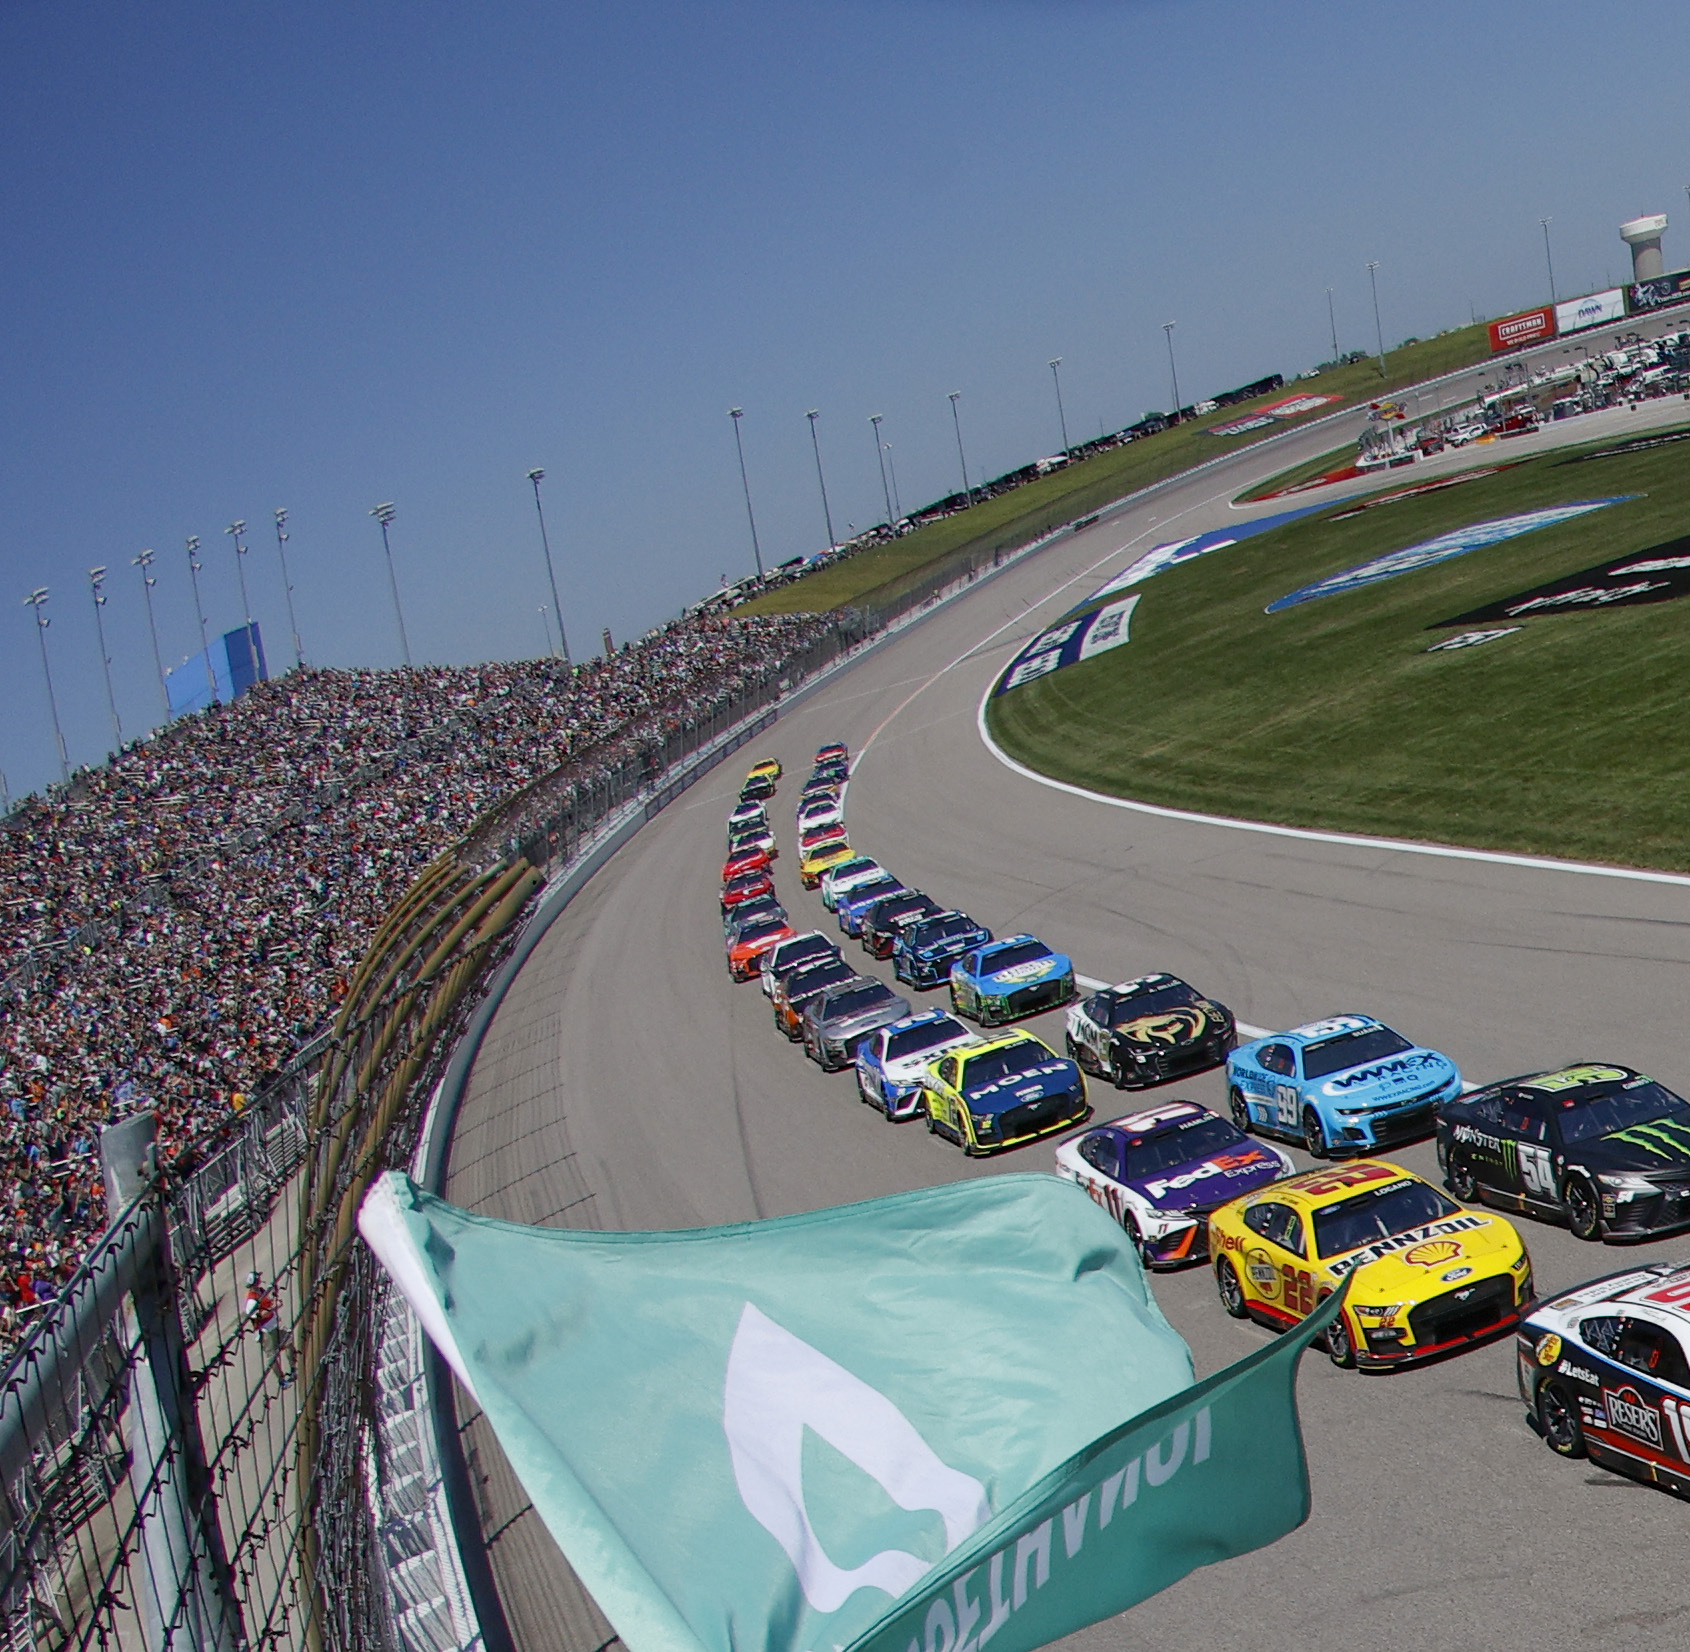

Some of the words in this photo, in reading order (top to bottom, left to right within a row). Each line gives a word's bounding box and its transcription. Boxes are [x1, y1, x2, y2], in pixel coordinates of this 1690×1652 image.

[969, 1060, 1070, 1101] MOEN
[1277, 1084, 1298, 1127] 99
[1144, 1150, 1267, 1199] FedEx
[1224, 1160, 1281, 1178] Express
[1375, 1180, 1413, 1197] LOGANO
[1519, 1144, 1551, 1194] 54
[1215, 1228, 1246, 1251] Shell
[1329, 1216, 1491, 1277] PENNZOIL
[1282, 1262, 1315, 1315] 22
[1558, 1358, 1600, 1387] #LetsEat
[1610, 1397, 1660, 1442] RESER'S
